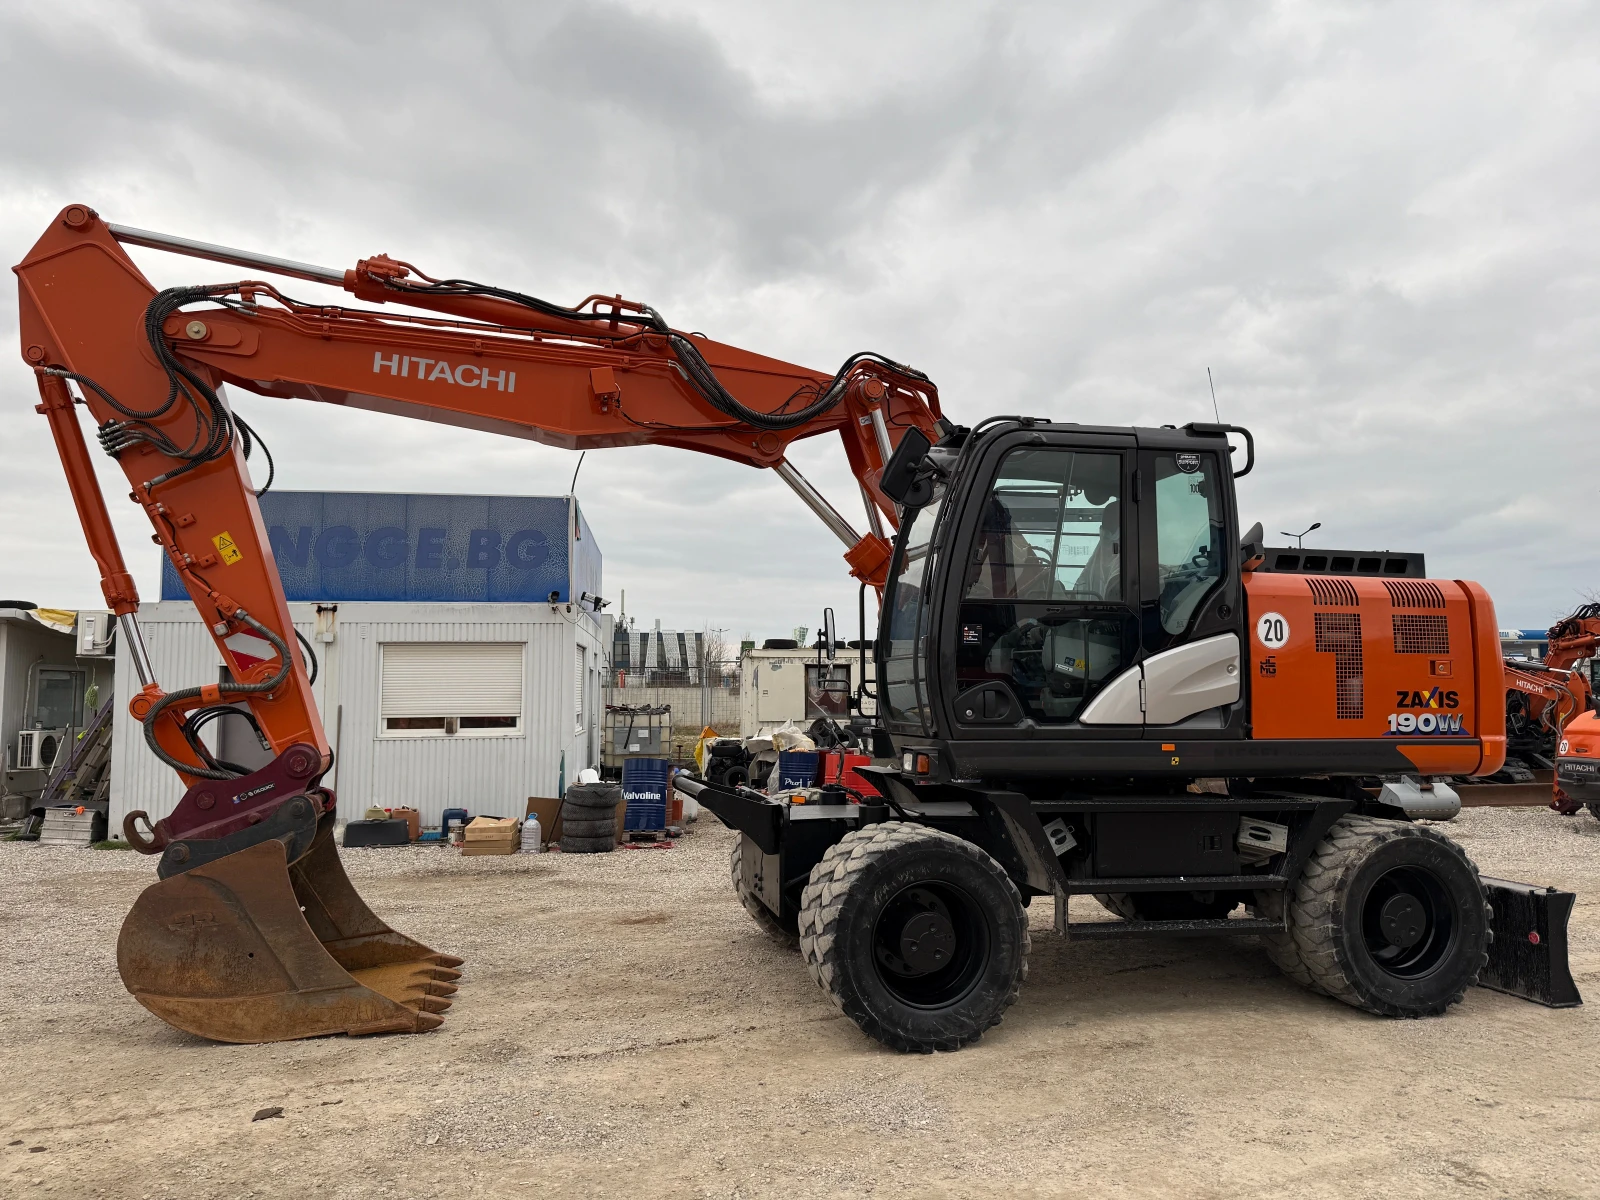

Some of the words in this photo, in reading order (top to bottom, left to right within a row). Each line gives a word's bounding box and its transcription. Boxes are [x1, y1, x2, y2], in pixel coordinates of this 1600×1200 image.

[373, 351, 516, 393] HITACHI
[1263, 618, 1284, 642] 20
[1516, 679, 1543, 694] HITACHI
[1396, 686, 1460, 709] ZAXIS
[1387, 712, 1464, 735] 190W
[1560, 742, 1568, 752] 20
[1564, 763, 1595, 772] HITACHI
[623, 791, 661, 800] Valvoline
